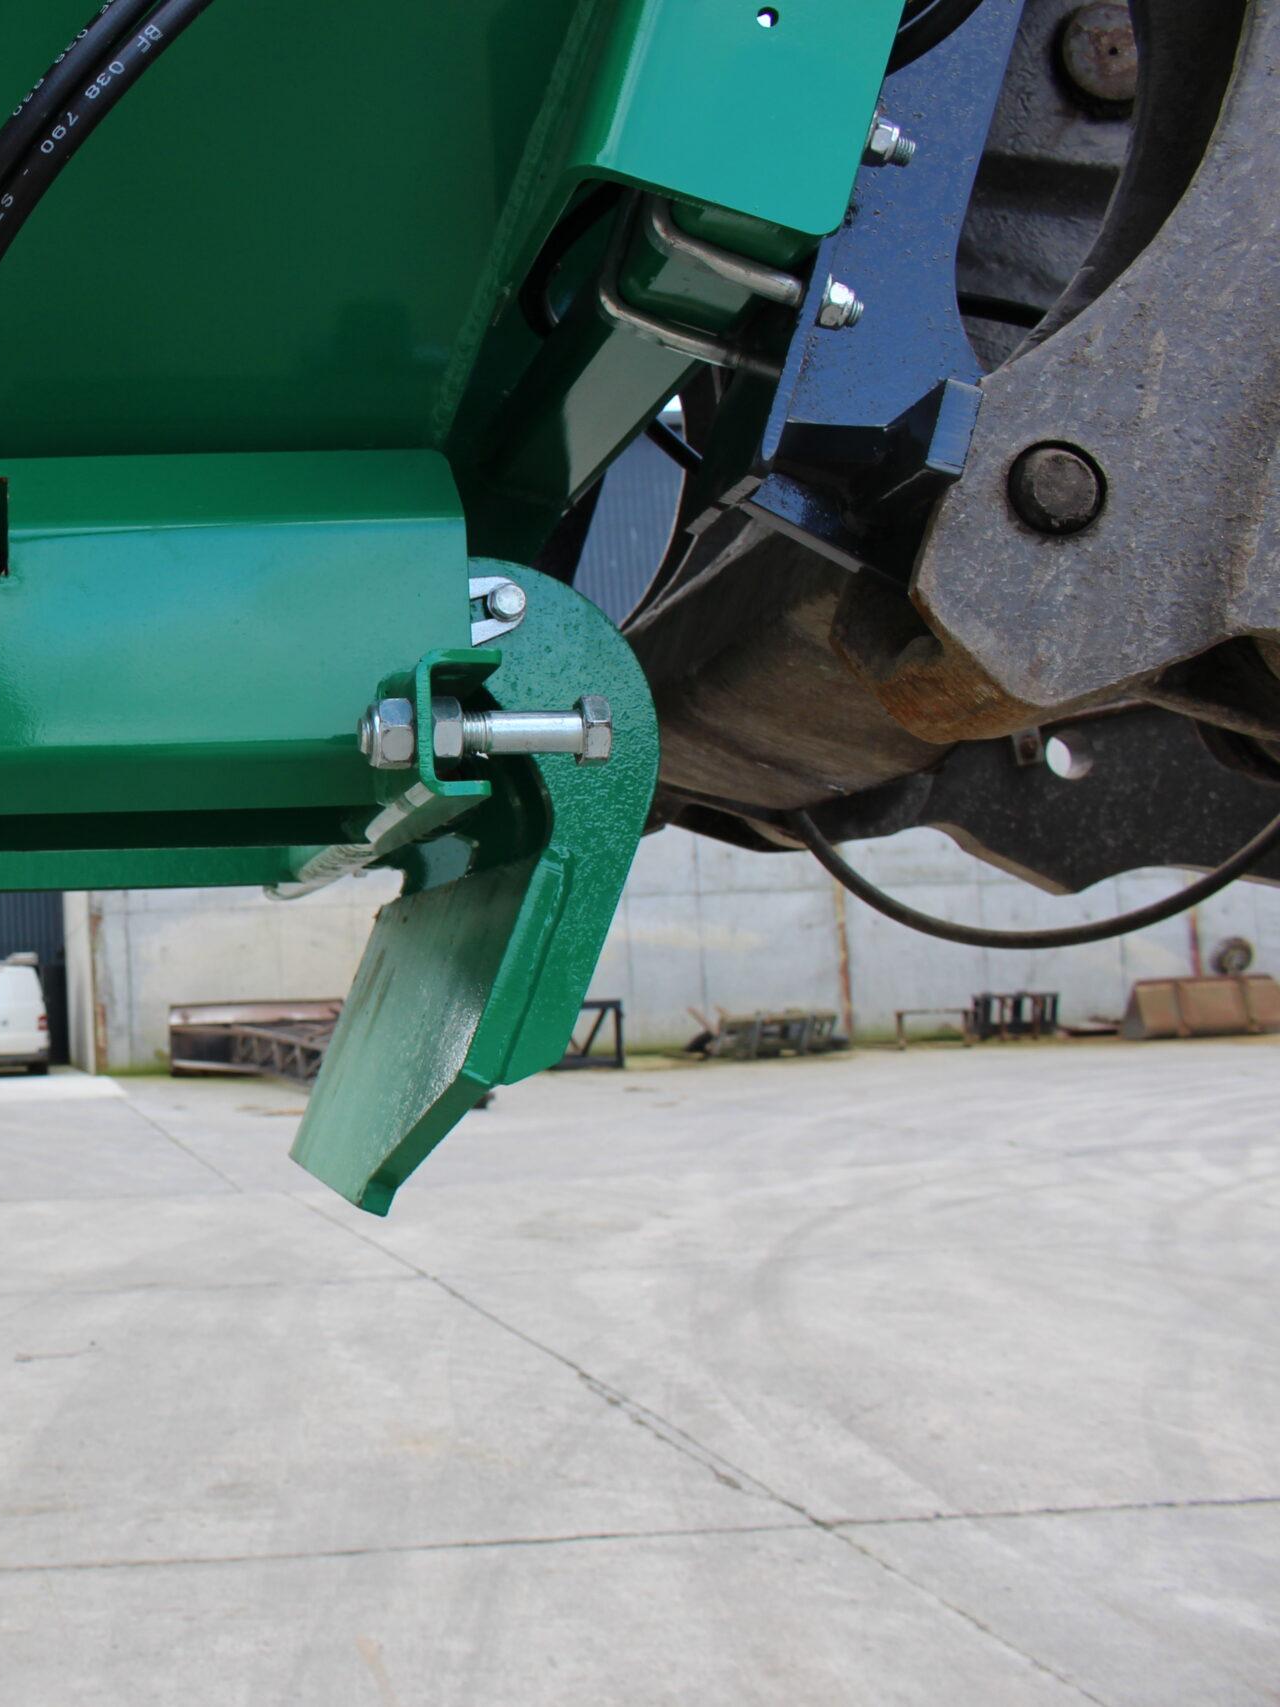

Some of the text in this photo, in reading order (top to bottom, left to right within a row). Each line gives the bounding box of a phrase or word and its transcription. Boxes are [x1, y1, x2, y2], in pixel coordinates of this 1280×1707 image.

[135, 23, 163, 53] BF
[84, 60, 125, 99] 038
[39, 111, 79, 154] 790
